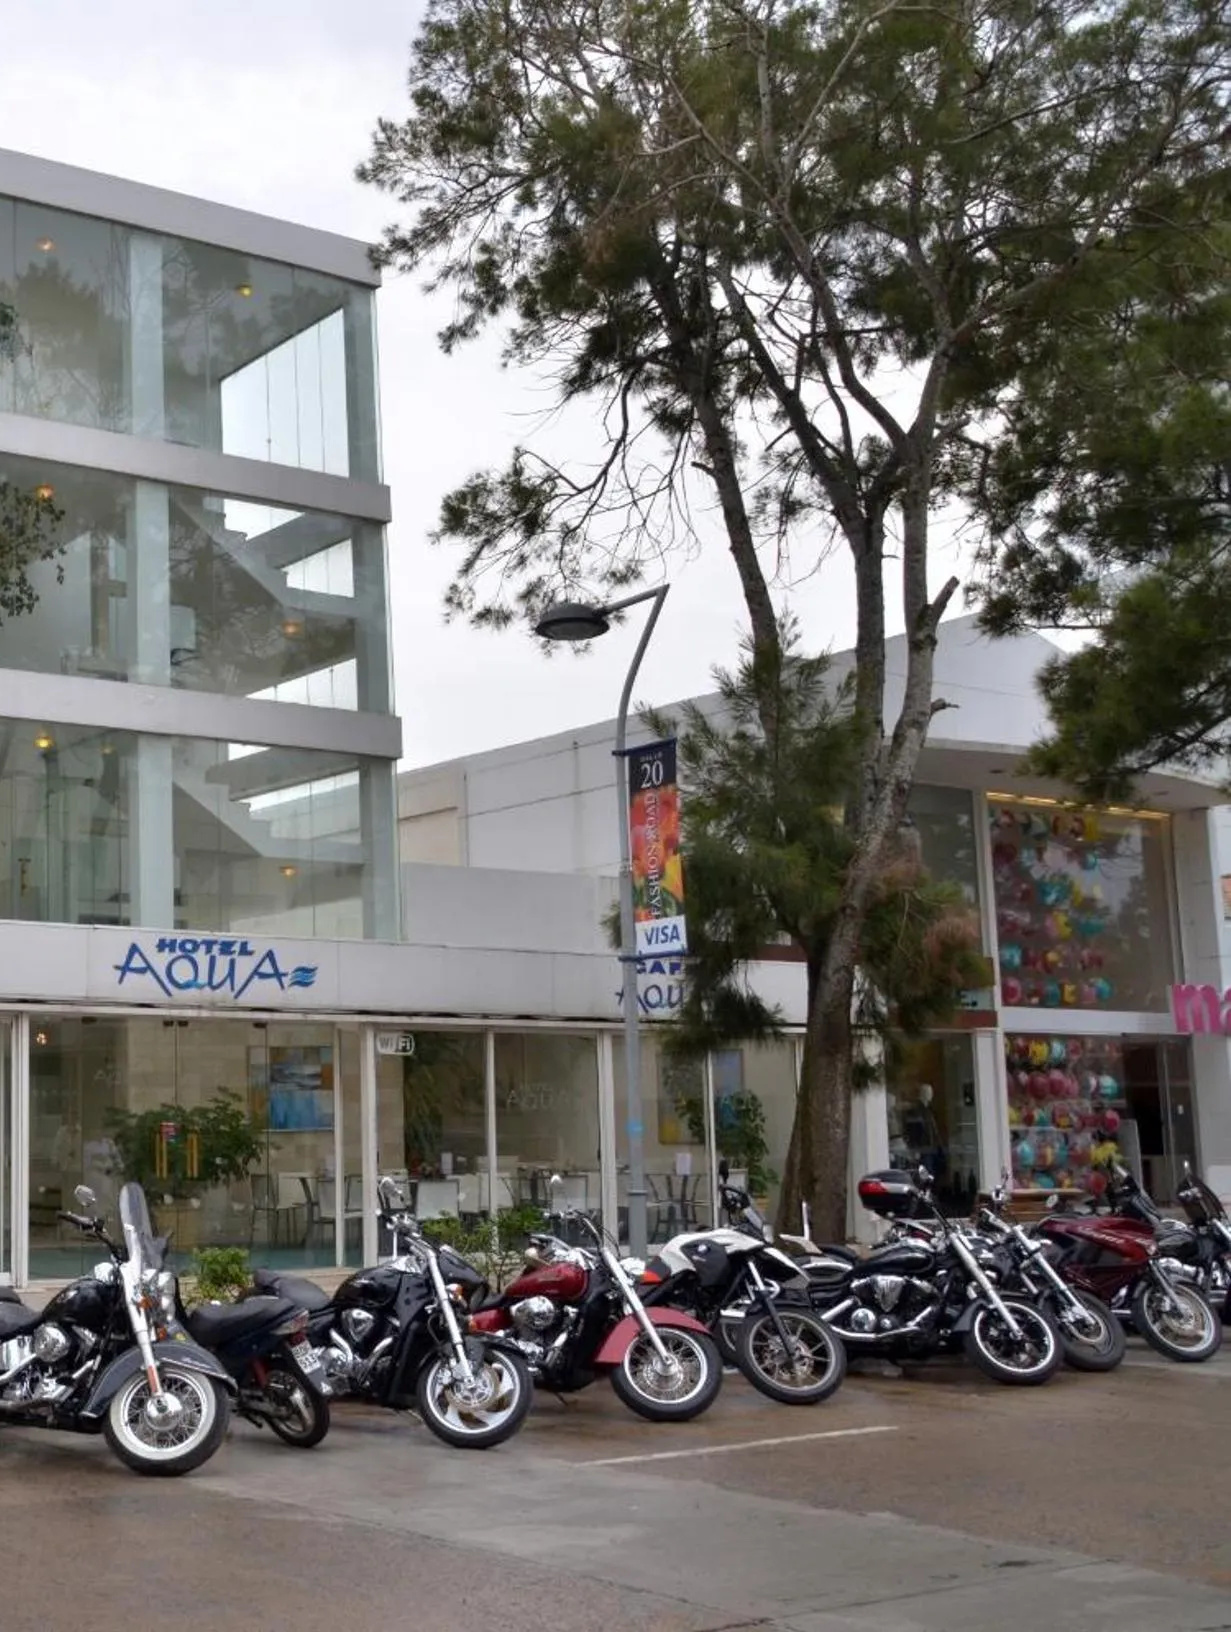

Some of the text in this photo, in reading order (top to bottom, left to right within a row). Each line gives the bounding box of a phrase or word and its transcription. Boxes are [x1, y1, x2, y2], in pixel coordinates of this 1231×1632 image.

[640, 760, 664, 789] 20
[156, 938, 255, 956] HOTEL
[644, 924, 681, 946] VISA
[113, 942, 289, 999] AQUA
